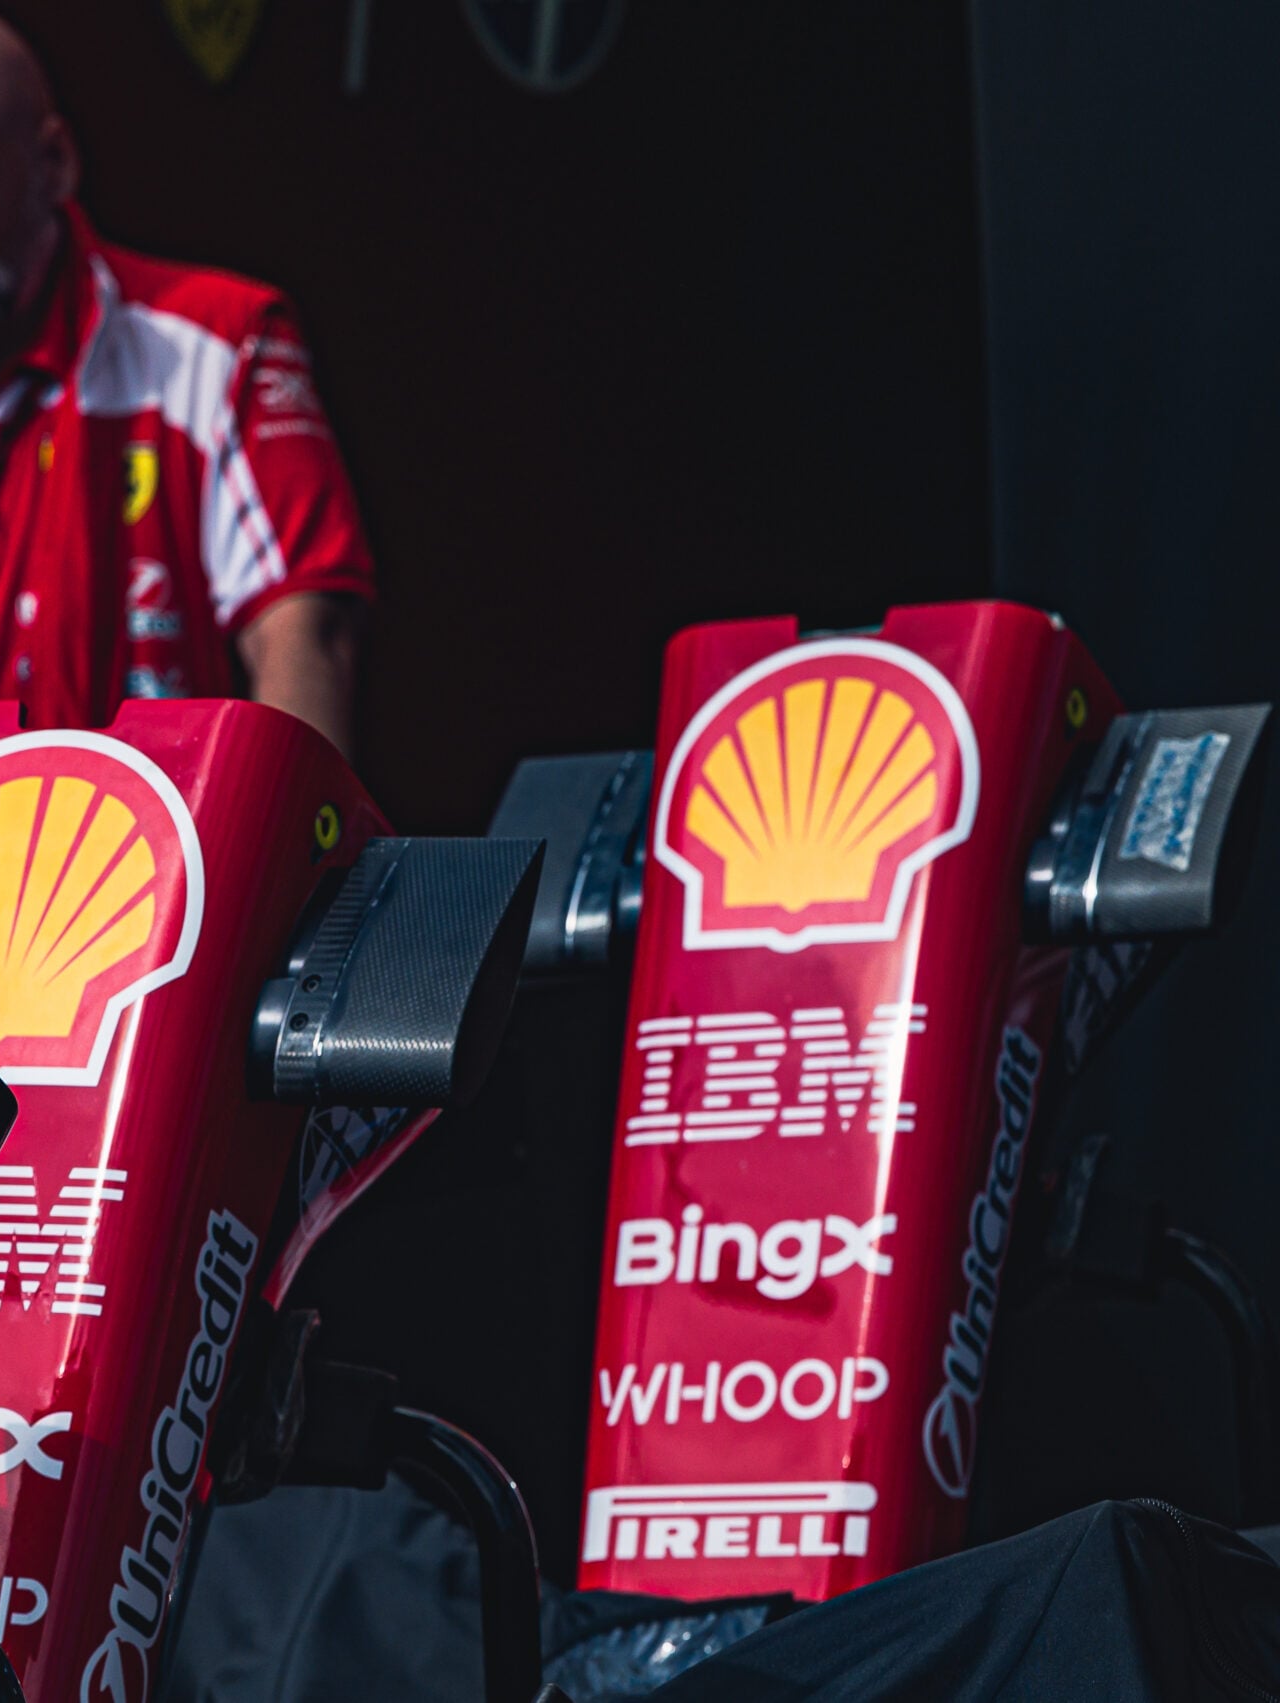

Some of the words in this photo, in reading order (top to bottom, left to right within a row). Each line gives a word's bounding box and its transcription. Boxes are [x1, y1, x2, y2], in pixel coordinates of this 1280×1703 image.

[625, 1003, 929, 1147] IBM
[944, 1025, 1042, 1402] UniCredit
[110, 1209, 258, 1649] UniCredit
[599, 1356, 890, 1427] WHOOP
[582, 1481, 878, 1562] PIRELLI
